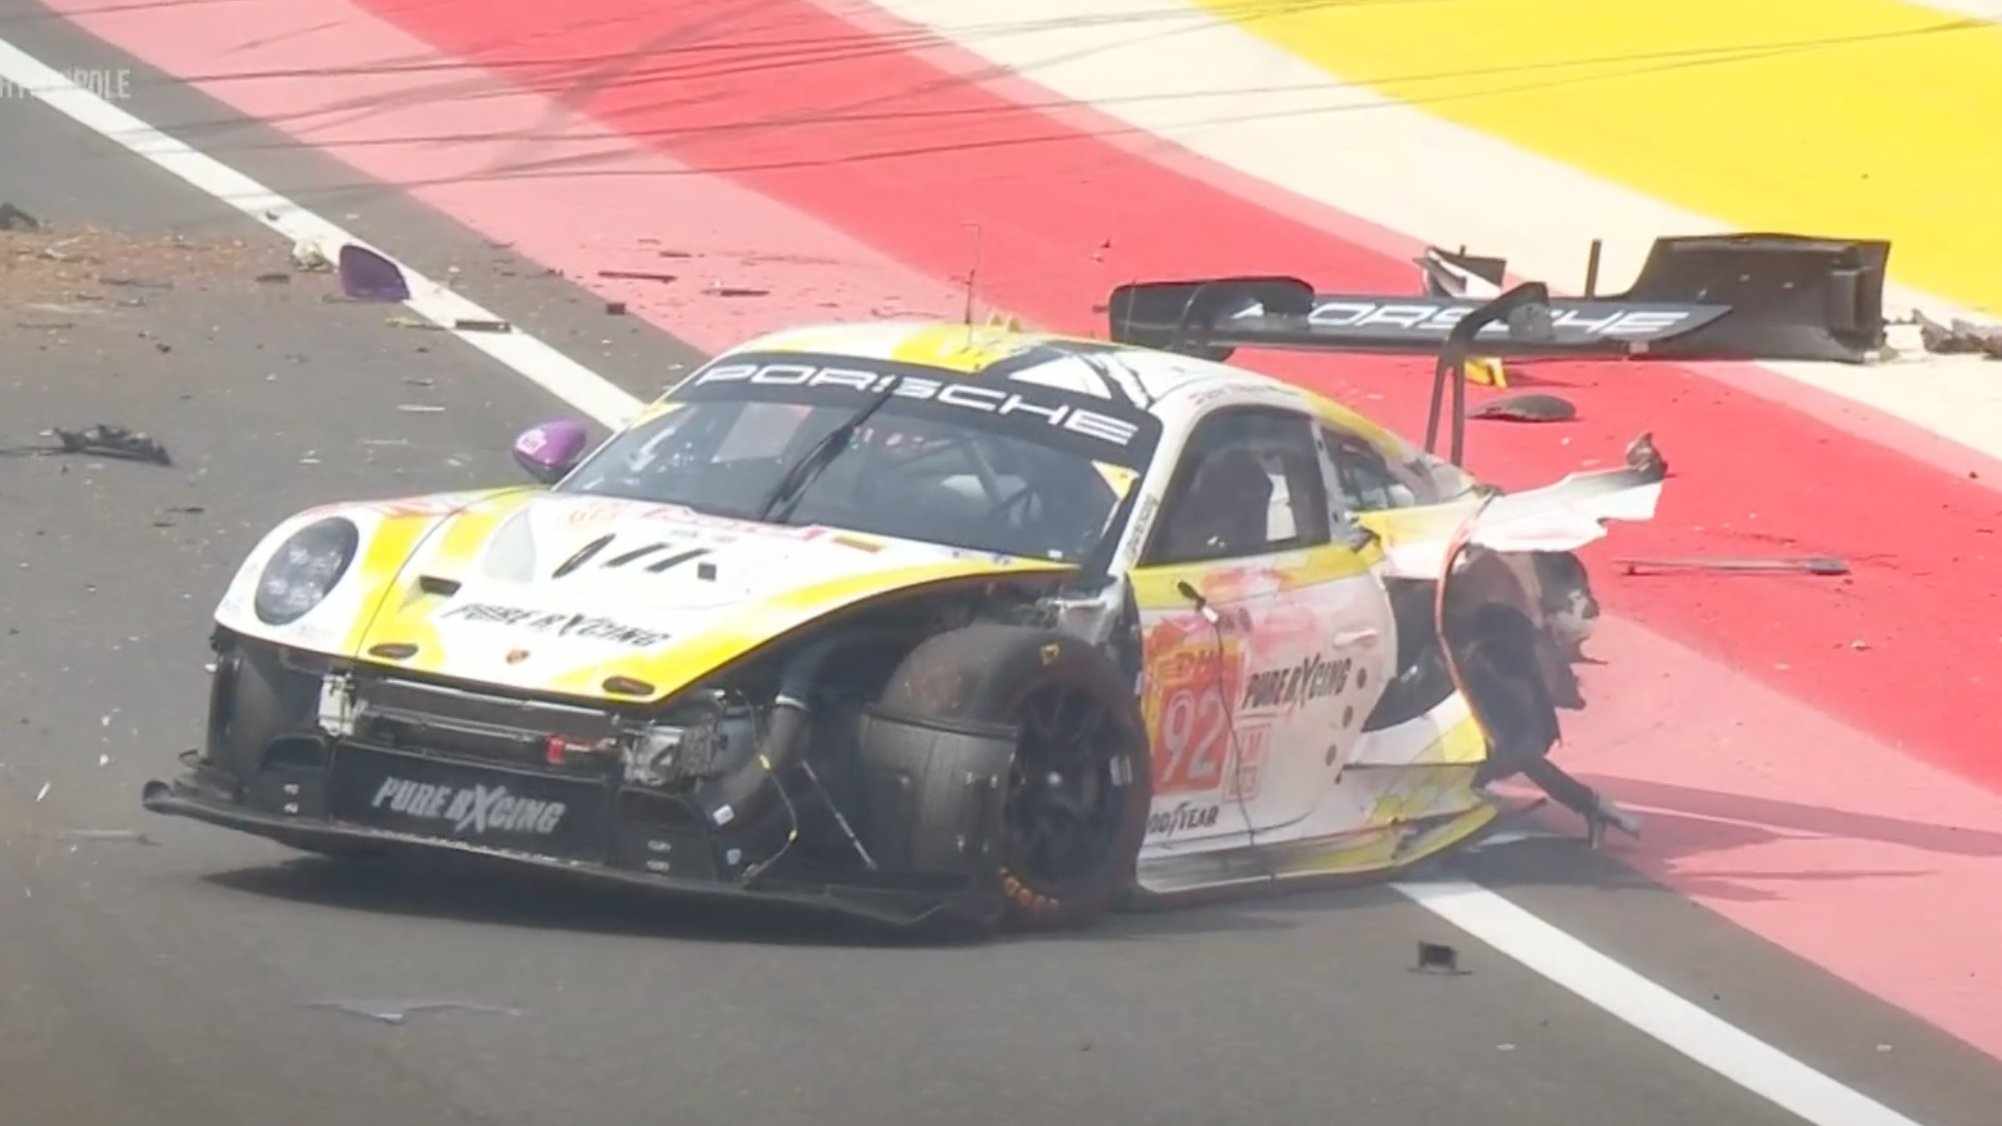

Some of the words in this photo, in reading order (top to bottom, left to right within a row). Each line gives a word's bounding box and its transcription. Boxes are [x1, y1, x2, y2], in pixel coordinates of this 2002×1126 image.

[1232, 302, 1690, 335] ORSHE
[695, 363, 1139, 446] PORSCHE
[1241, 667, 1292, 710] PURE
[1161, 686, 1222, 785] 92
[371, 776, 452, 818] PURE
